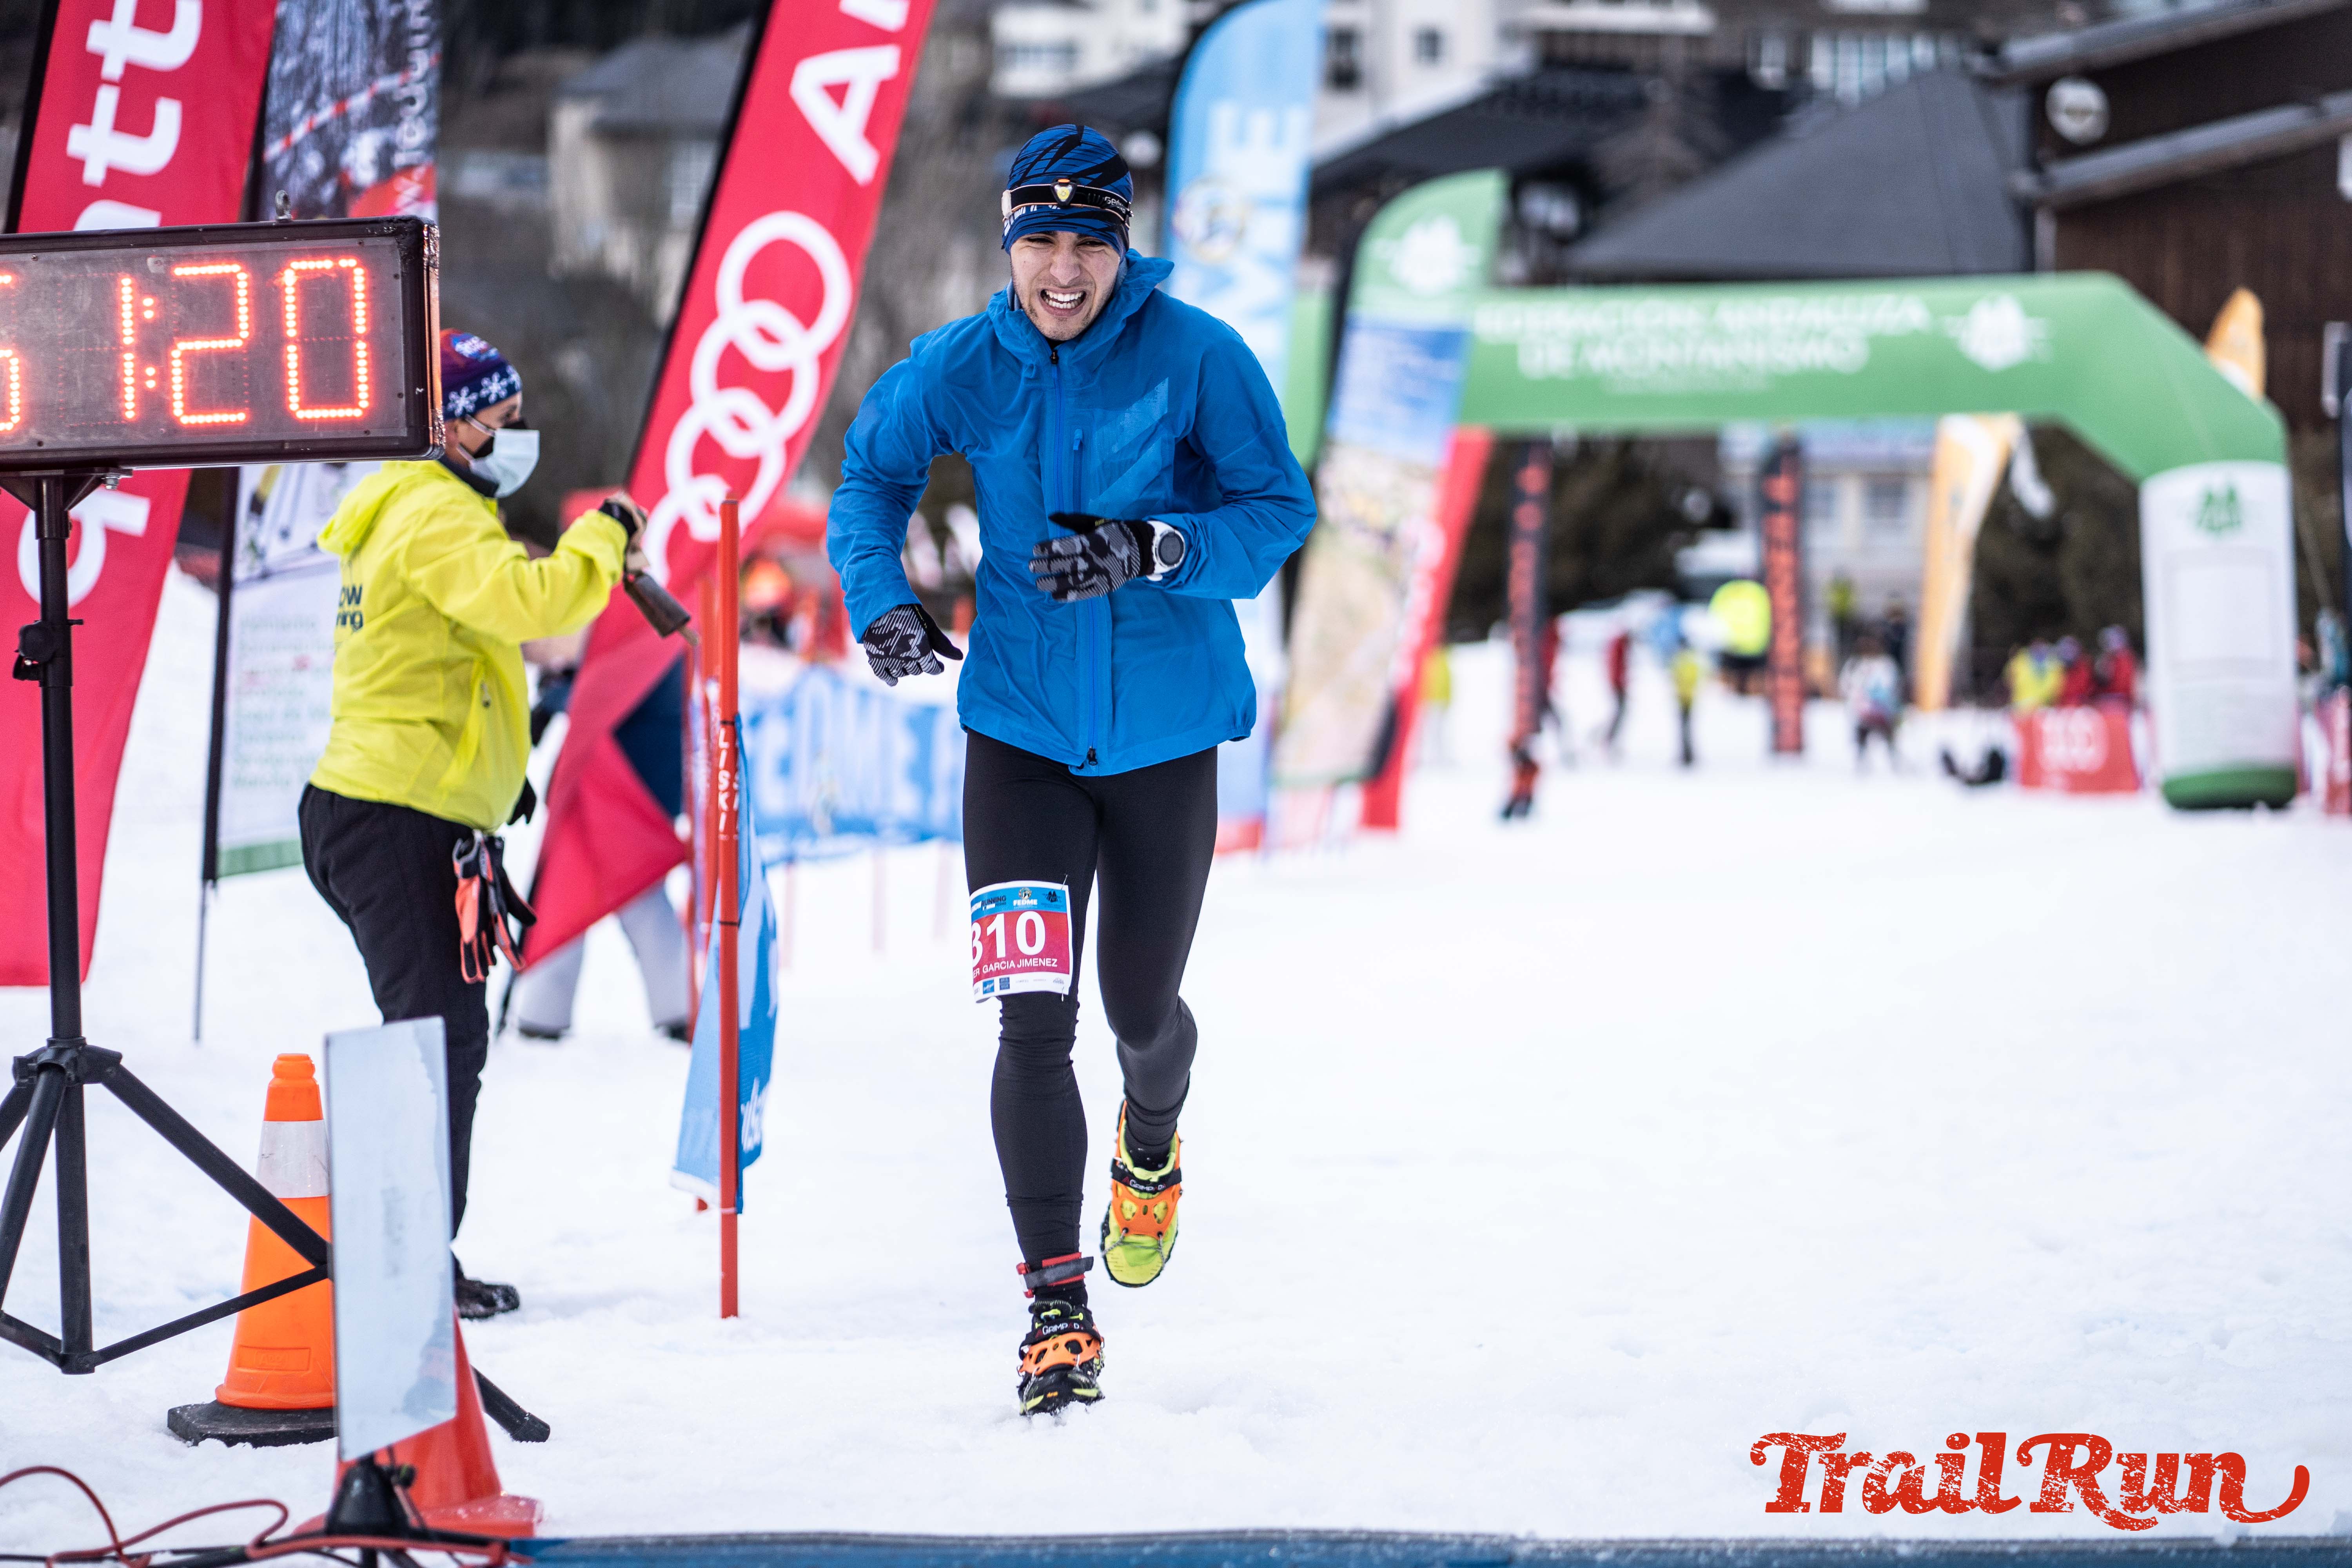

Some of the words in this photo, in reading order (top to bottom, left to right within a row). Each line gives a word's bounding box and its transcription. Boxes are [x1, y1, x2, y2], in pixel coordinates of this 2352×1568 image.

[0, 258, 373, 433] 1:20
[718, 728, 731, 832] LISKI
[981, 895, 1006, 907] RUNNING
[982, 960, 1015, 974] GARCIA
[1017, 958, 1058, 968] JIMENEZ
